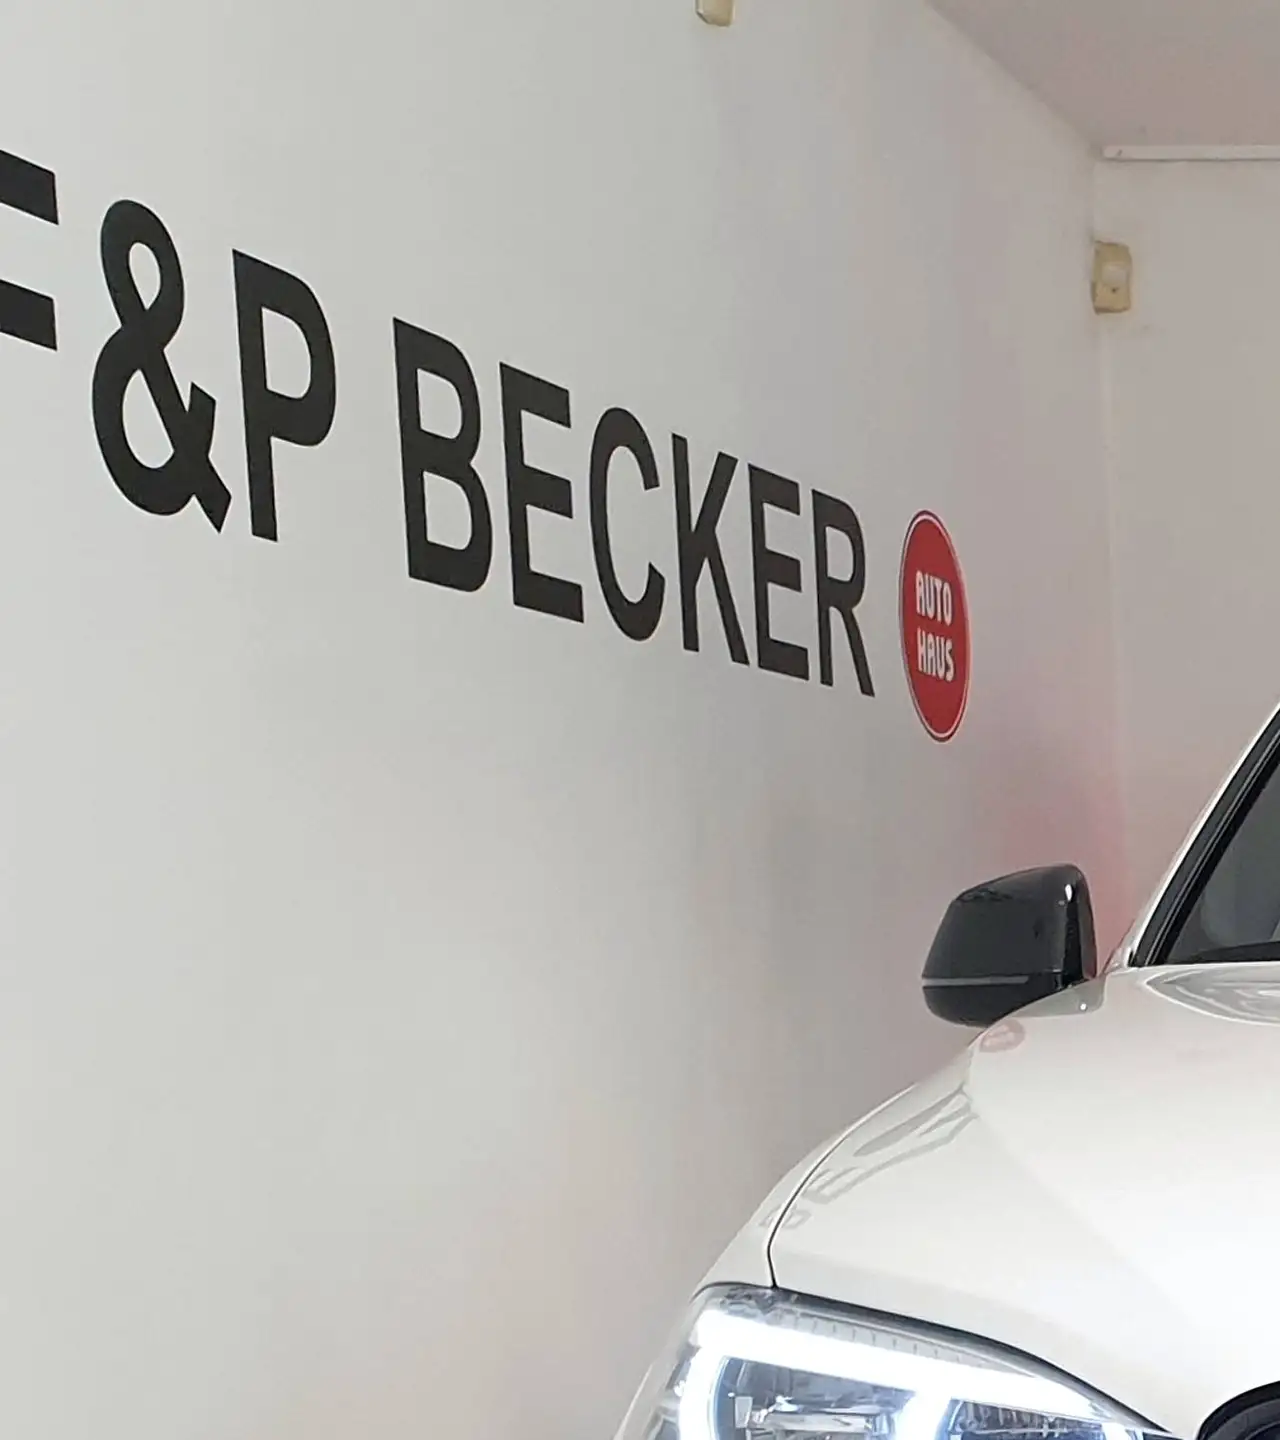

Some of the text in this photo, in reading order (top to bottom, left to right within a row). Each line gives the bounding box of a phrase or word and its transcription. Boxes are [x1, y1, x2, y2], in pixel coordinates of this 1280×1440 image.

[392, 316, 876, 698] BECKER
[915, 570, 953, 626] AUTO
[916, 628, 955, 682] HAUS
